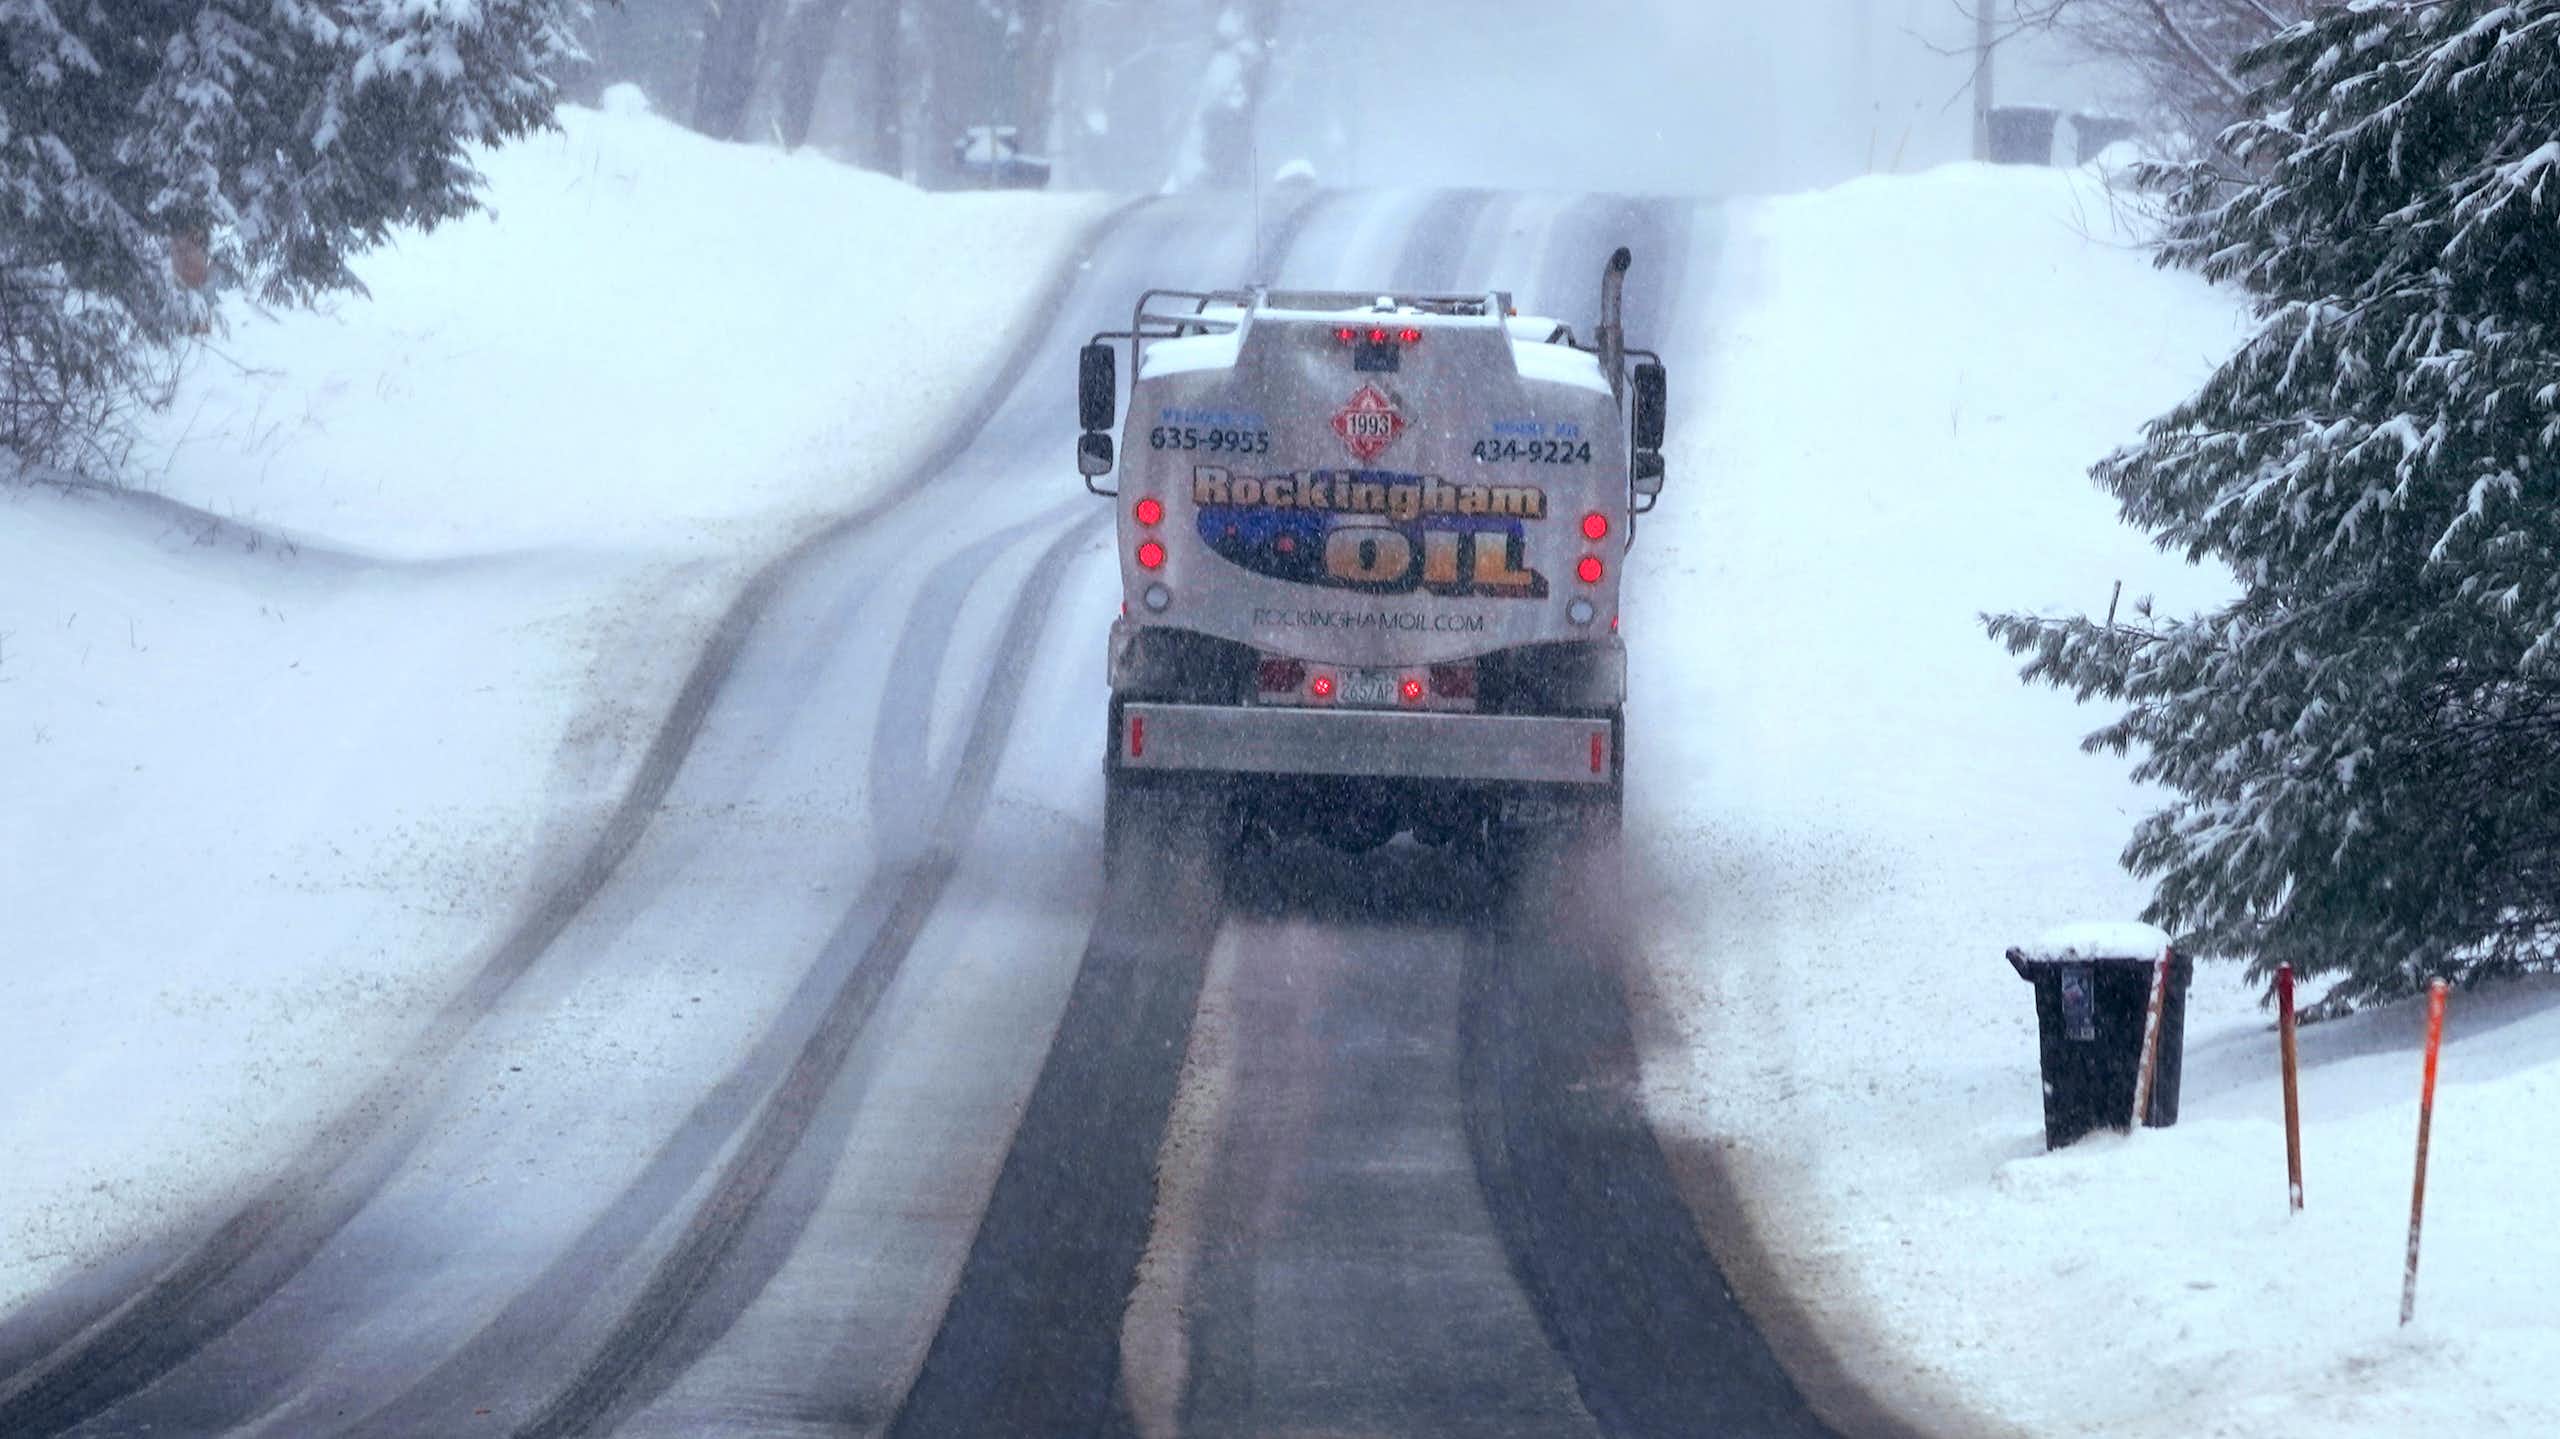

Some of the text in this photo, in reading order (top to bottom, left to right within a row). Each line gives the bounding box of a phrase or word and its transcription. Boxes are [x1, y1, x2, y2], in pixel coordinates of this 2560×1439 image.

[1350, 414, 1389, 435] 1993
[1150, 426, 1269, 453] 635-9955
[1472, 439, 1592, 464] 434-9224
[1193, 465, 1546, 521] Rockingham
[1324, 526, 1547, 596] OIL
[1253, 607, 1484, 633] ROCKINGHAMOIL.COM
